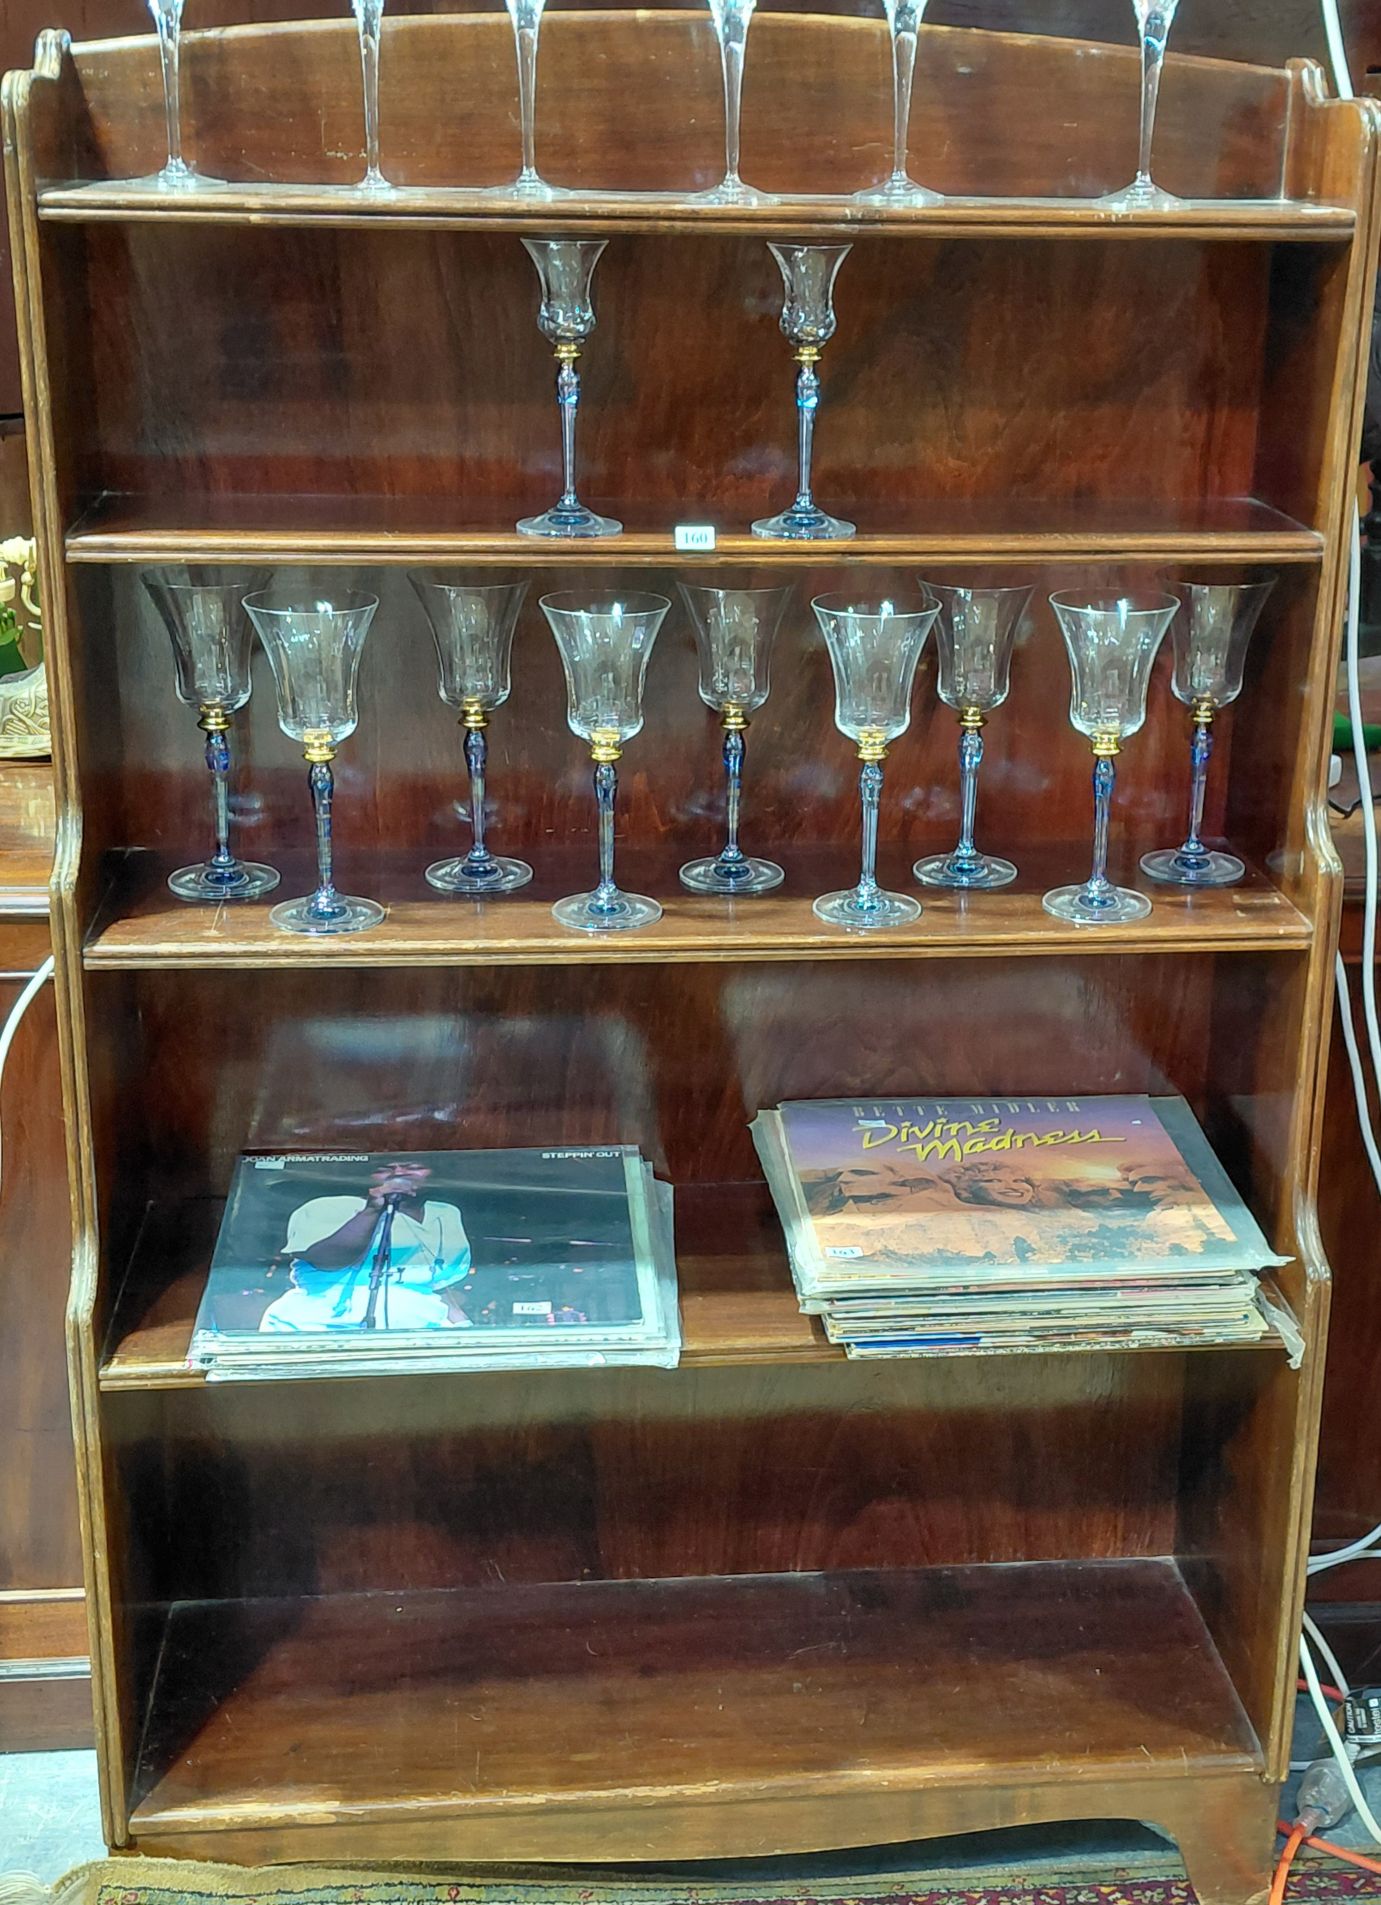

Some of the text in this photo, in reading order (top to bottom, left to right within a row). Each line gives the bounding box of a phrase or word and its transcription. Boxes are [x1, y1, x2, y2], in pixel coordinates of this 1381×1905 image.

[684, 531, 708, 544] 160
[852, 1101, 1081, 1117] BETTE MIDLER
[852, 1117, 1001, 1149] Divine
[897, 1128, 1126, 1162] Madness
[278, 1154, 369, 1162] ARMATRADING
[541, 1151, 595, 1159] STEPPIN'
[1345, 1703, 1355, 1734] CAUTION
